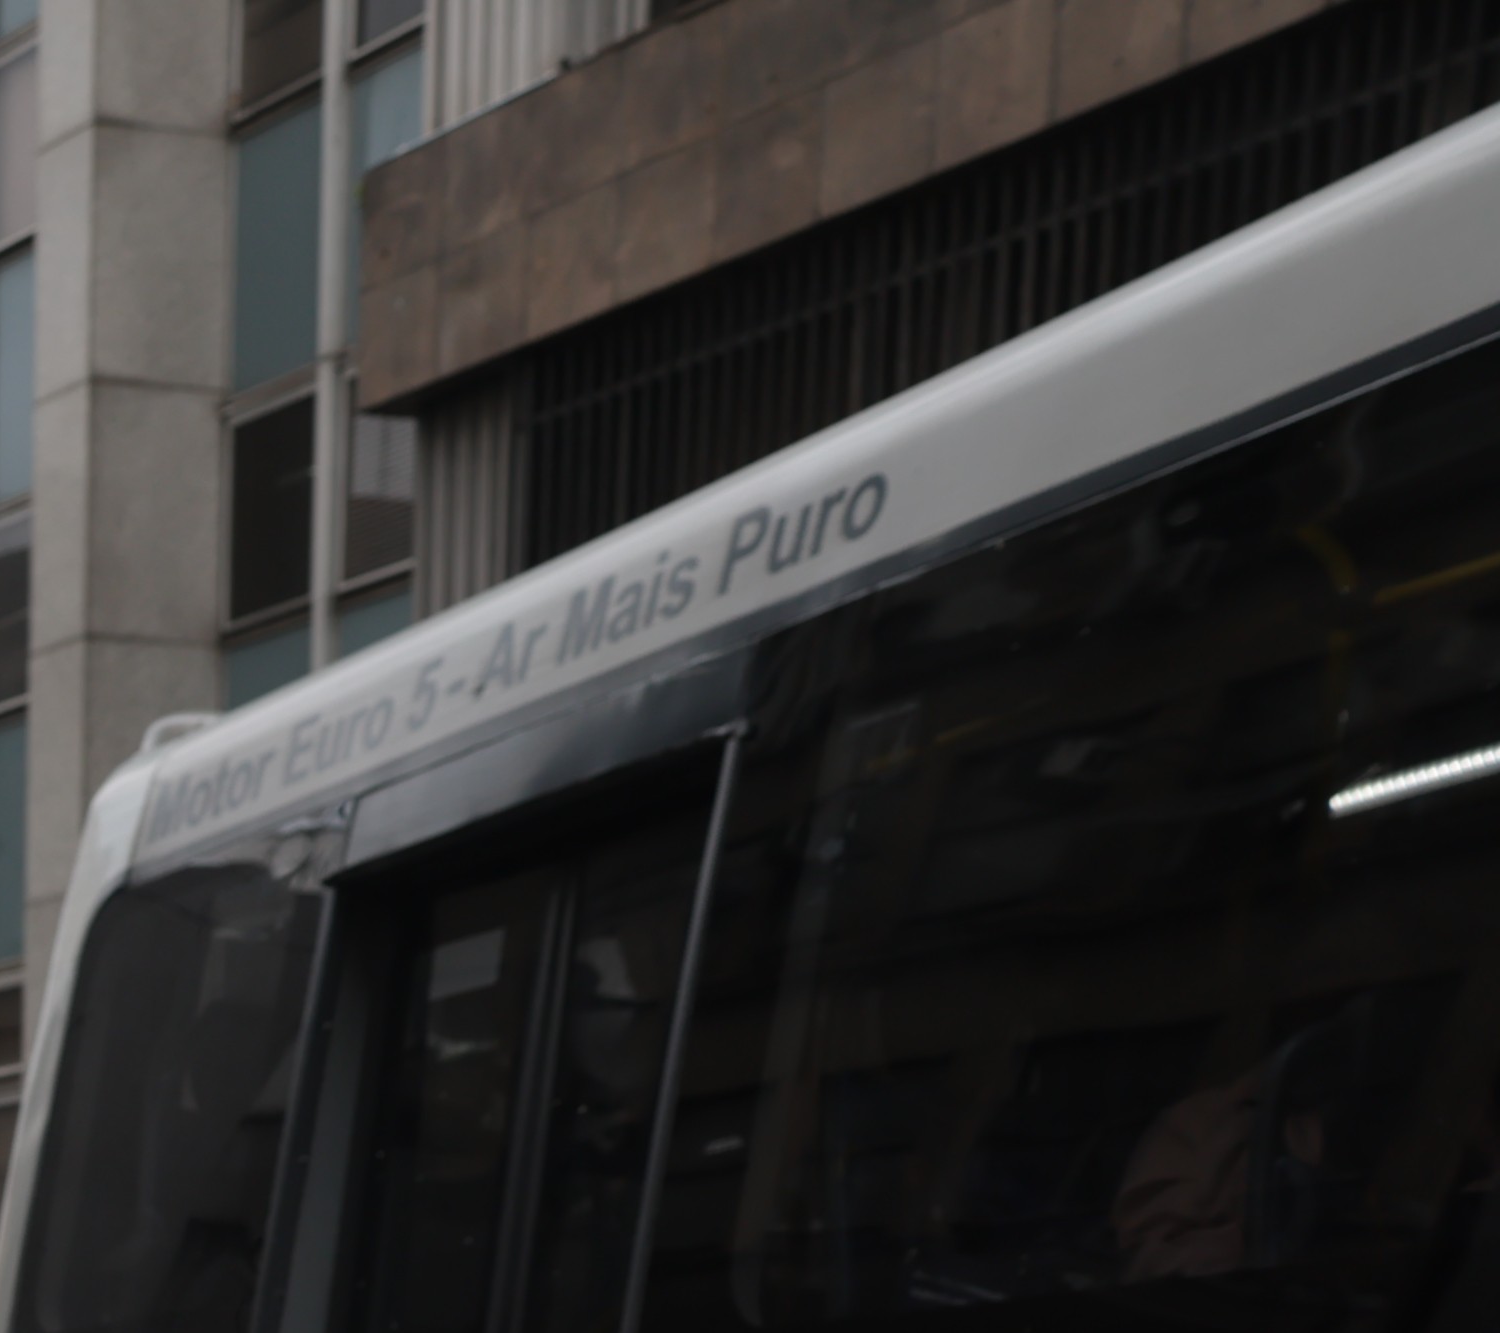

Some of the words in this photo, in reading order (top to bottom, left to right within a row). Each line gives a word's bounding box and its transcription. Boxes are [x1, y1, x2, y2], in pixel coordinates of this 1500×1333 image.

[148, 749, 275, 843] Motor
[282, 696, 396, 787] Euro
[555, 548, 701, 666] Mais
[716, 472, 888, 596] Puro
